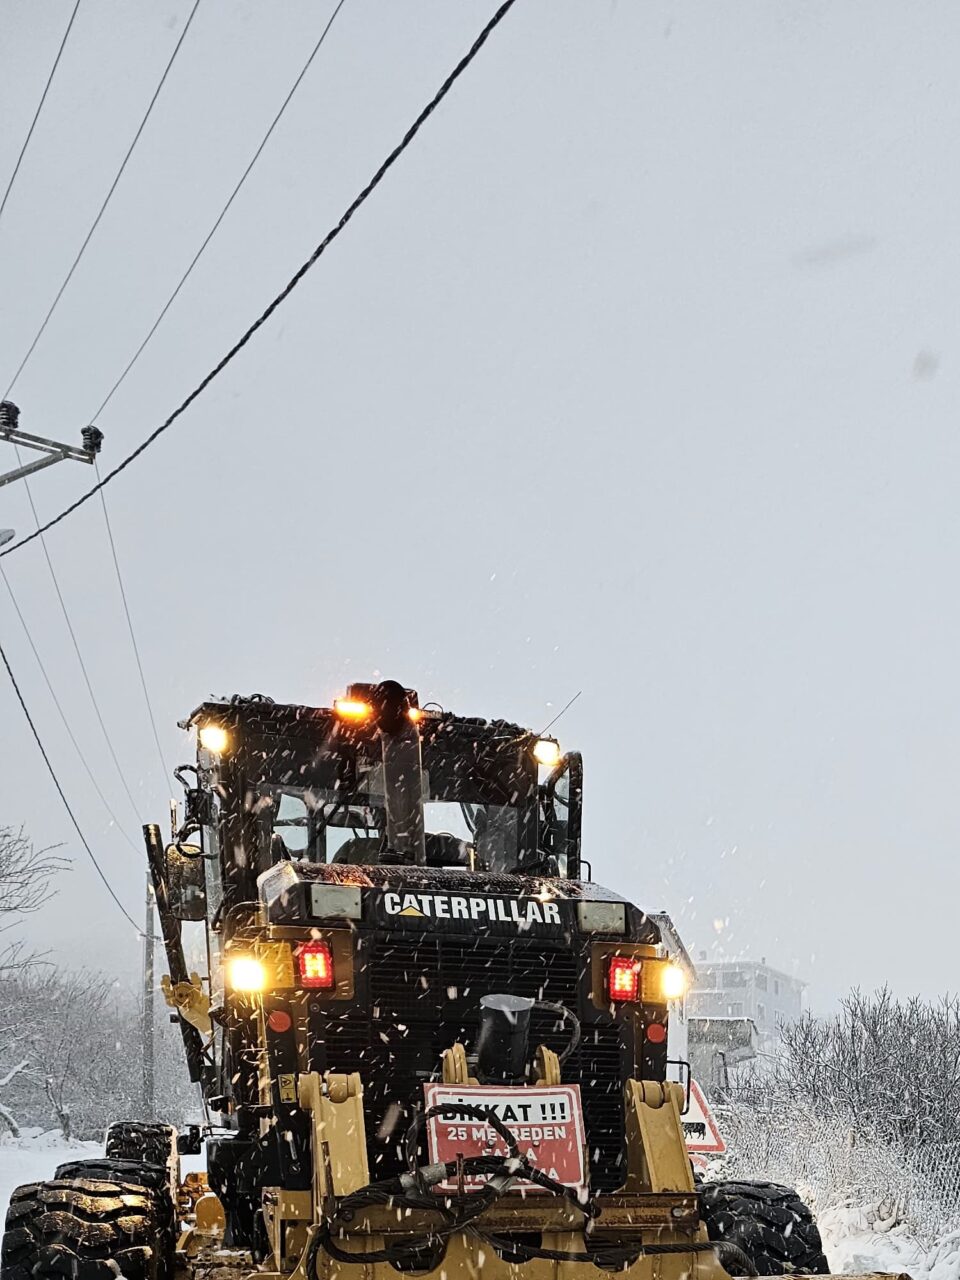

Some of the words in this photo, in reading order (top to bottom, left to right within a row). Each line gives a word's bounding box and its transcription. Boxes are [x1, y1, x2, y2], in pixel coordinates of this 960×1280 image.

[384, 892, 562, 925] CATERPILLAR
[540, 1102, 567, 1121] !!!
[447, 1127, 468, 1141] 25
[472, 1125, 567, 1142] MEREDEN
